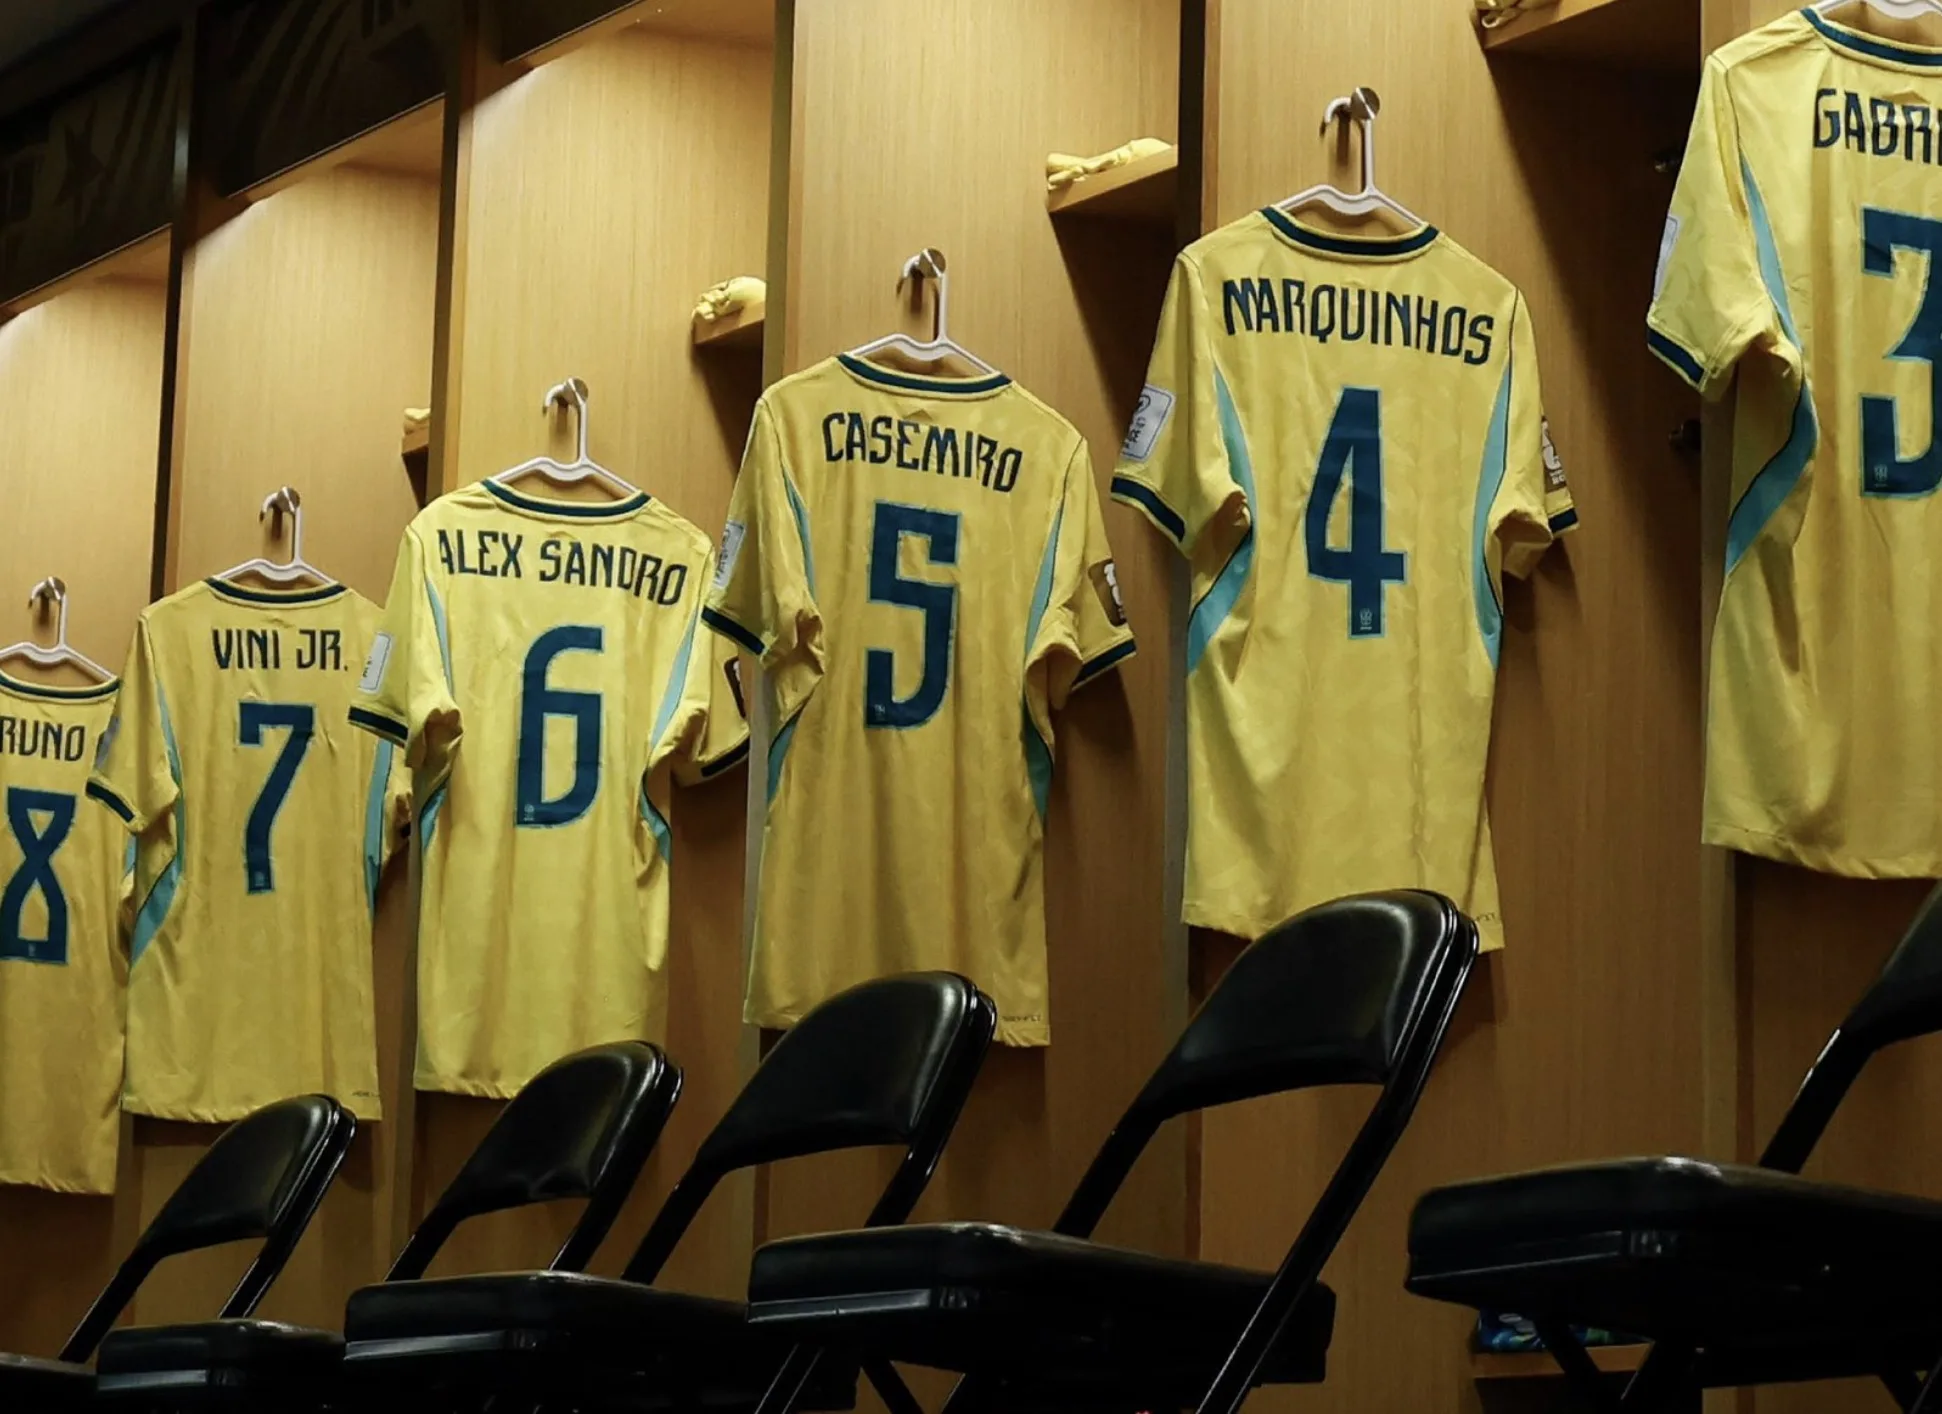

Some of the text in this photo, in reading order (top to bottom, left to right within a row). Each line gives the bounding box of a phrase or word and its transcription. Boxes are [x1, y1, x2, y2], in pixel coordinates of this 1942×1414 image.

[1223, 277, 1494, 366] MARQUINHOS
[1860, 206, 1942, 500] 3
[822, 412, 1023, 493] CASEMIRO
[1304, 386, 1406, 638] 4
[212, 629, 280, 670] VINI
[297, 629, 348, 671] JR.
[438, 529, 523, 578] ALEX
[539, 540, 688, 606] SANDRO
[863, 501, 962, 733] 5
[0, 715, 85, 762] RUNO
[238, 701, 315, 896] 7
[513, 625, 604, 829] 6
[0, 786, 77, 967] 8
